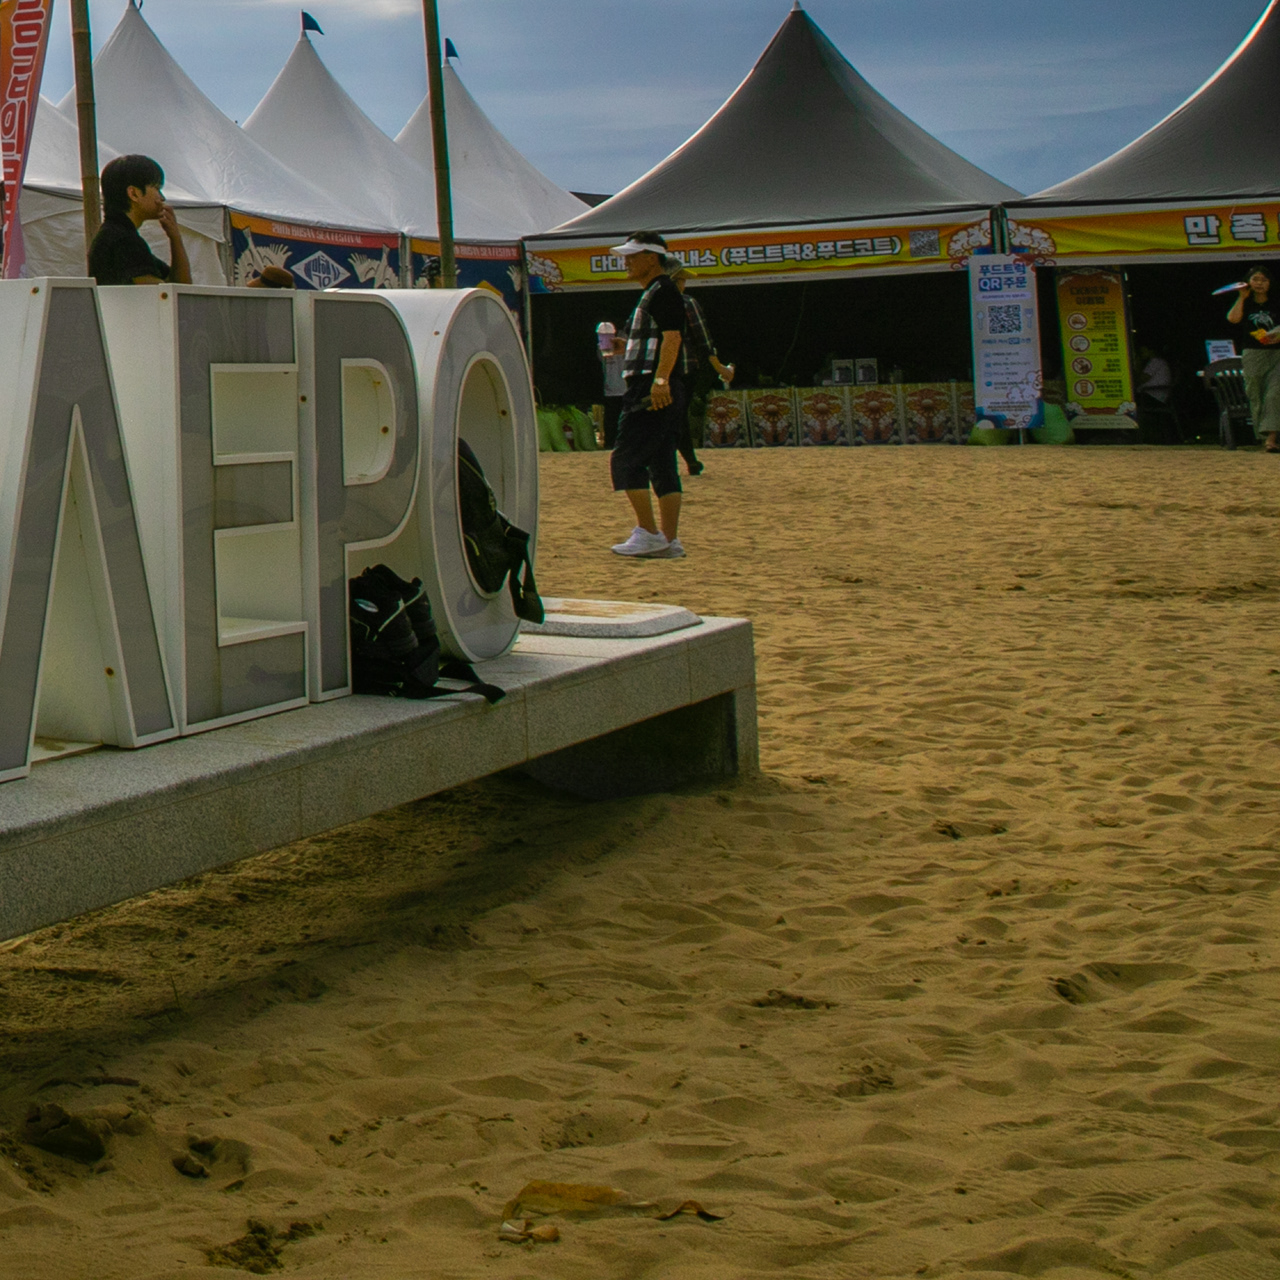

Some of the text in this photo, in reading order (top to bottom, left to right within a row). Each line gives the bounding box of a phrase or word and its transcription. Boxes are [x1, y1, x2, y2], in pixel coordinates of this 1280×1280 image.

[1184, 212, 1280, 245] 만족
[721, 236, 902, 266] (푸드트럭&푸드코트)
[979, 263, 1027, 276] 푸드트럭
[980, 276, 1027, 290] QR 주문
